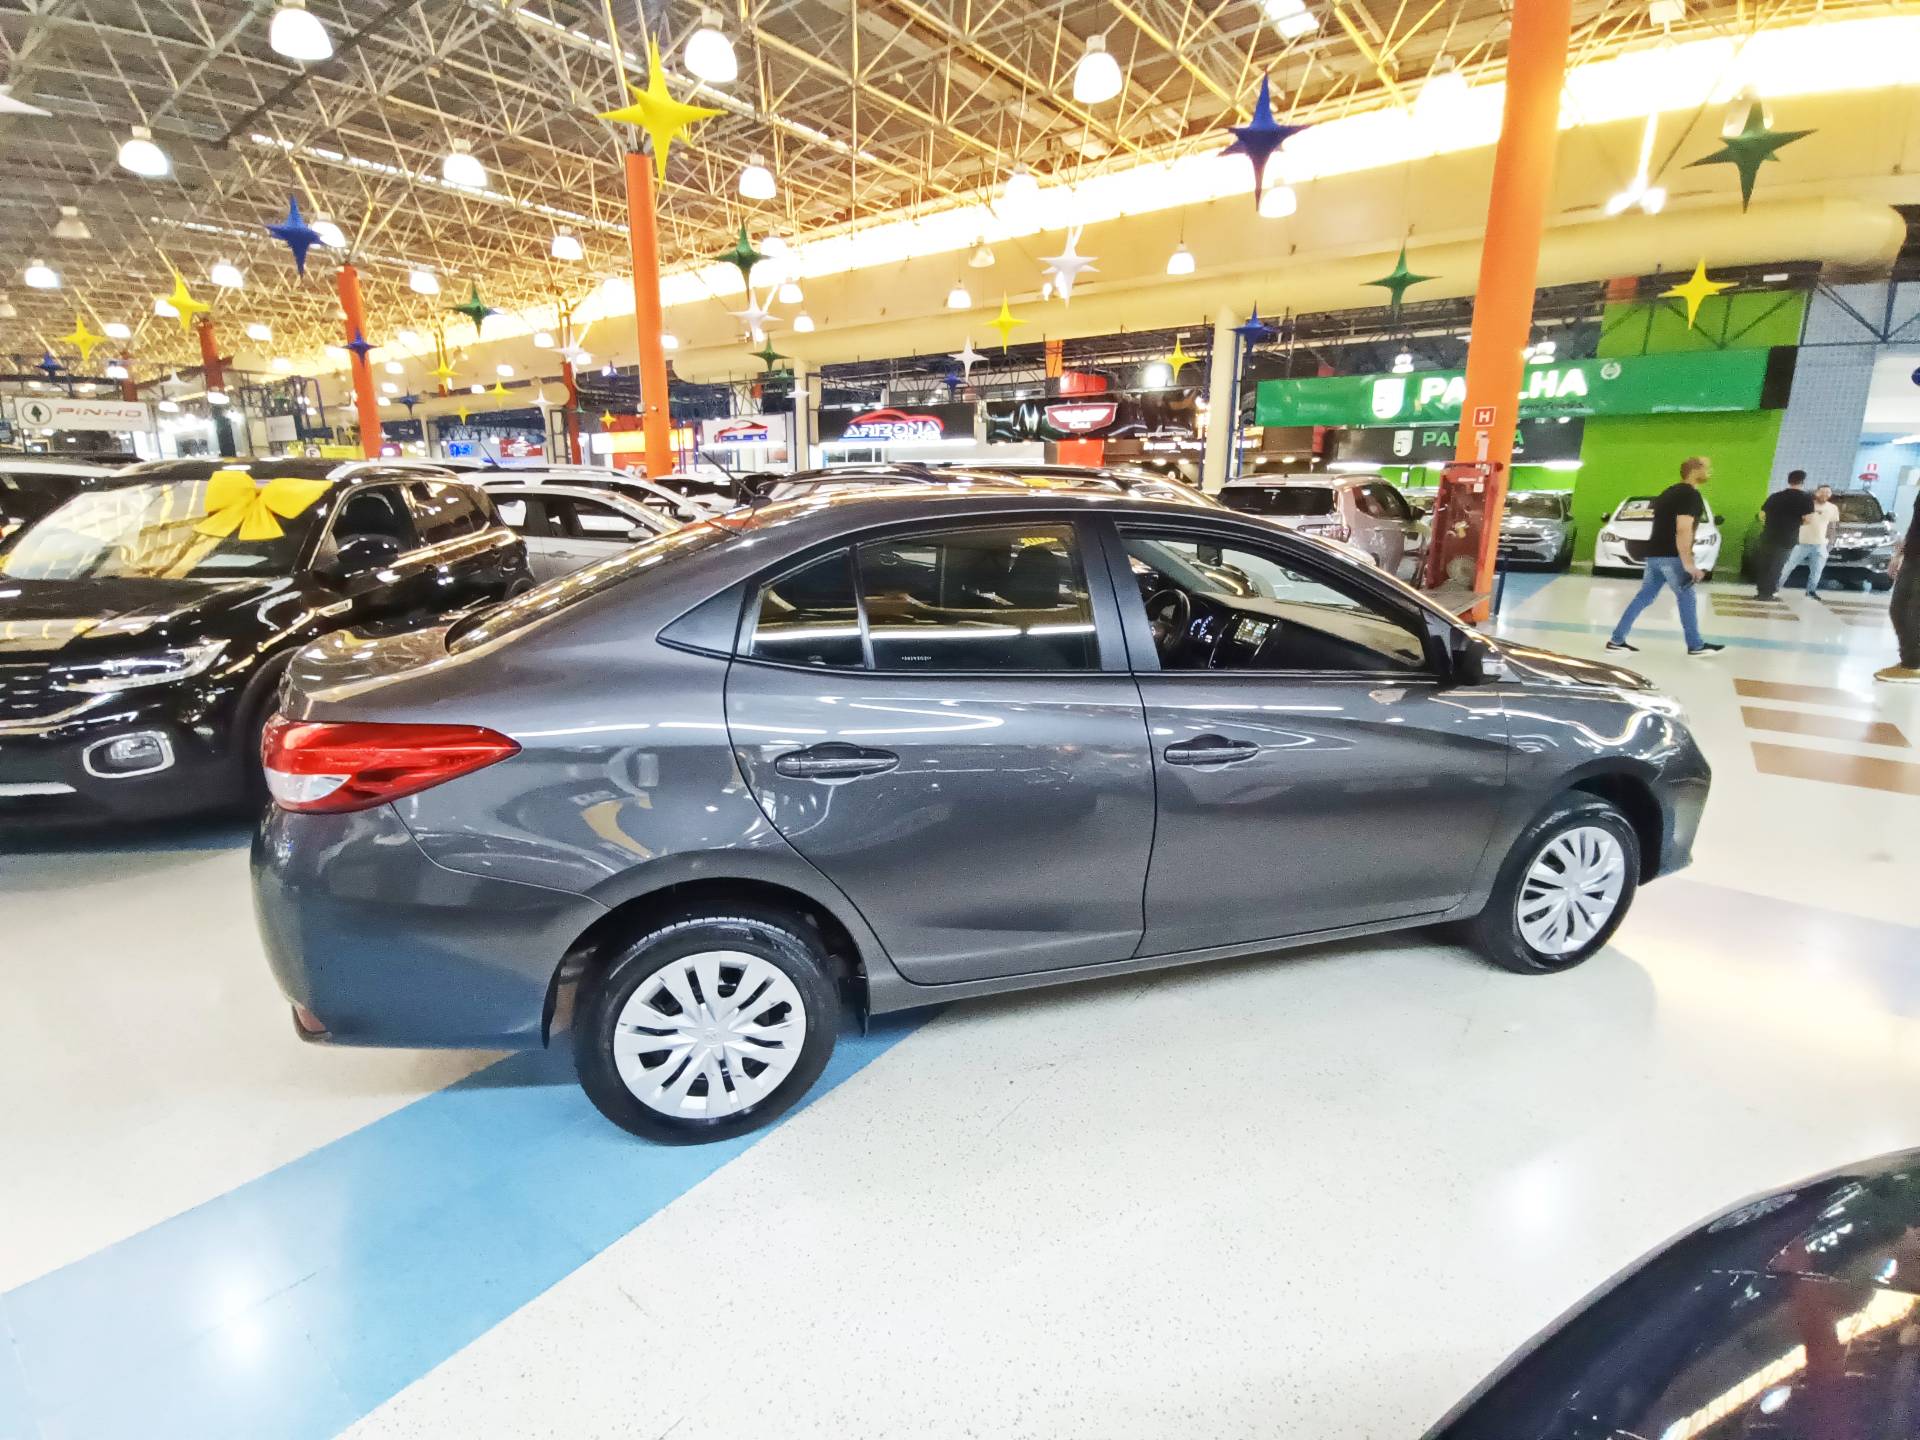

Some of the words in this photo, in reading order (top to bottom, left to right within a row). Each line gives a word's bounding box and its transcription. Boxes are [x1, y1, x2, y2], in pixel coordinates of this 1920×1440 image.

[56, 407, 142, 418] PINHO
[1478, 411, 1490, 423] H
[843, 420, 942, 439] ARIZONA
